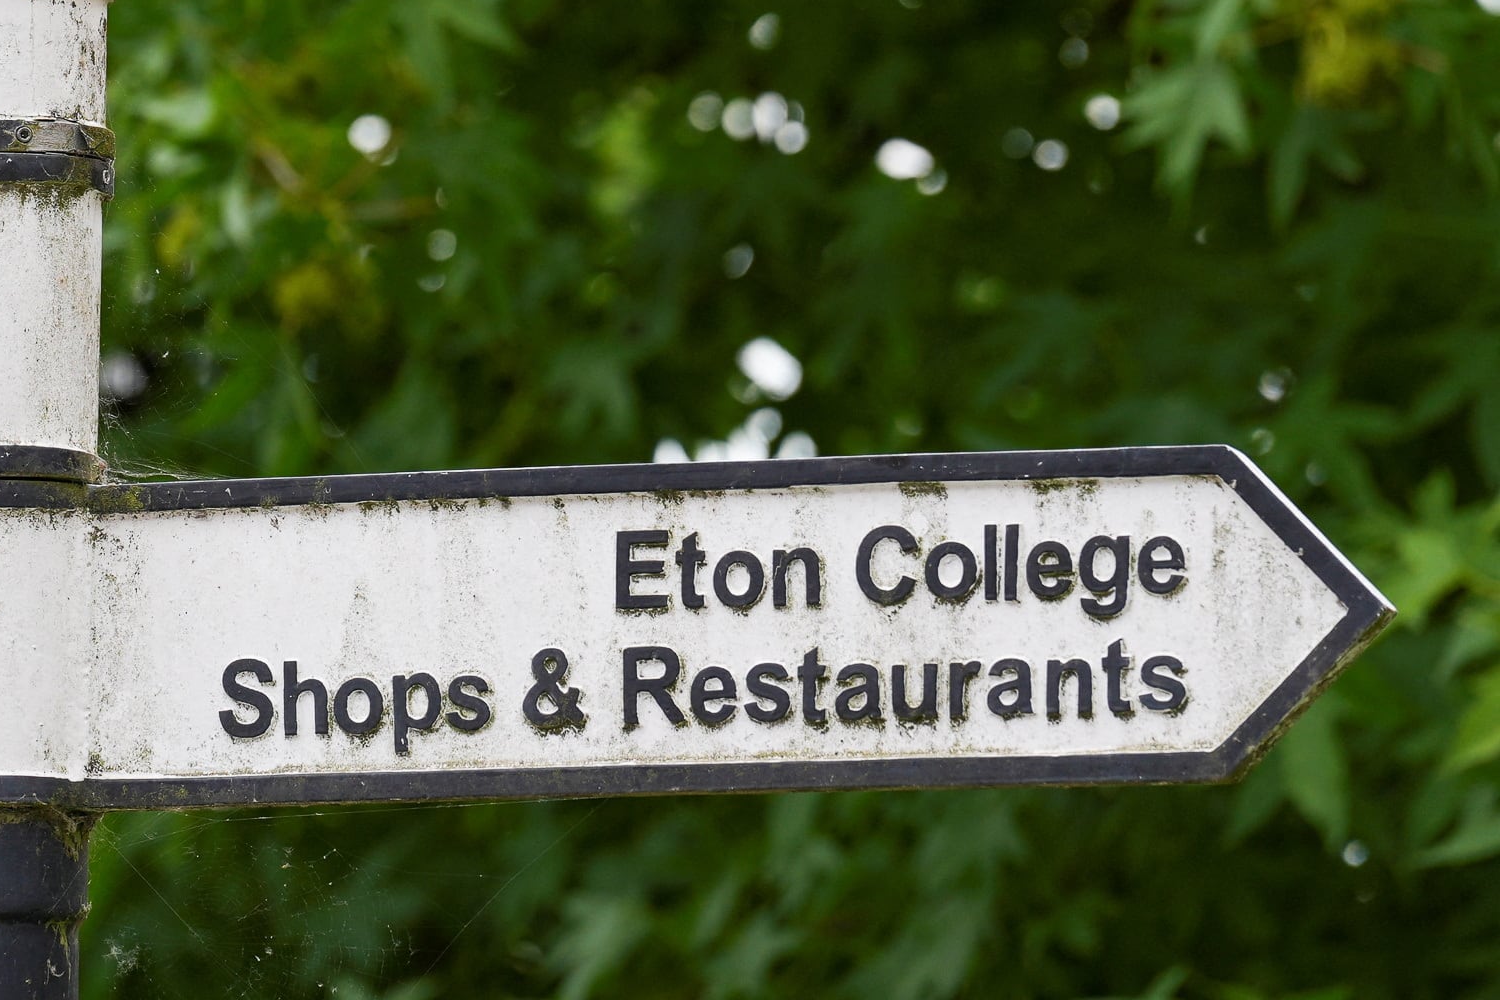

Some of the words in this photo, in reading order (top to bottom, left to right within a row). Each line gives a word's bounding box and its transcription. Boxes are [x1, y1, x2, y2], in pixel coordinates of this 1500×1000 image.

[616, 530, 821, 616] Eton
[856, 525, 1185, 619] College
[219, 659, 490, 752] Shops
[523, 649, 587, 735] &
[623, 640, 1188, 731] Restaurants
